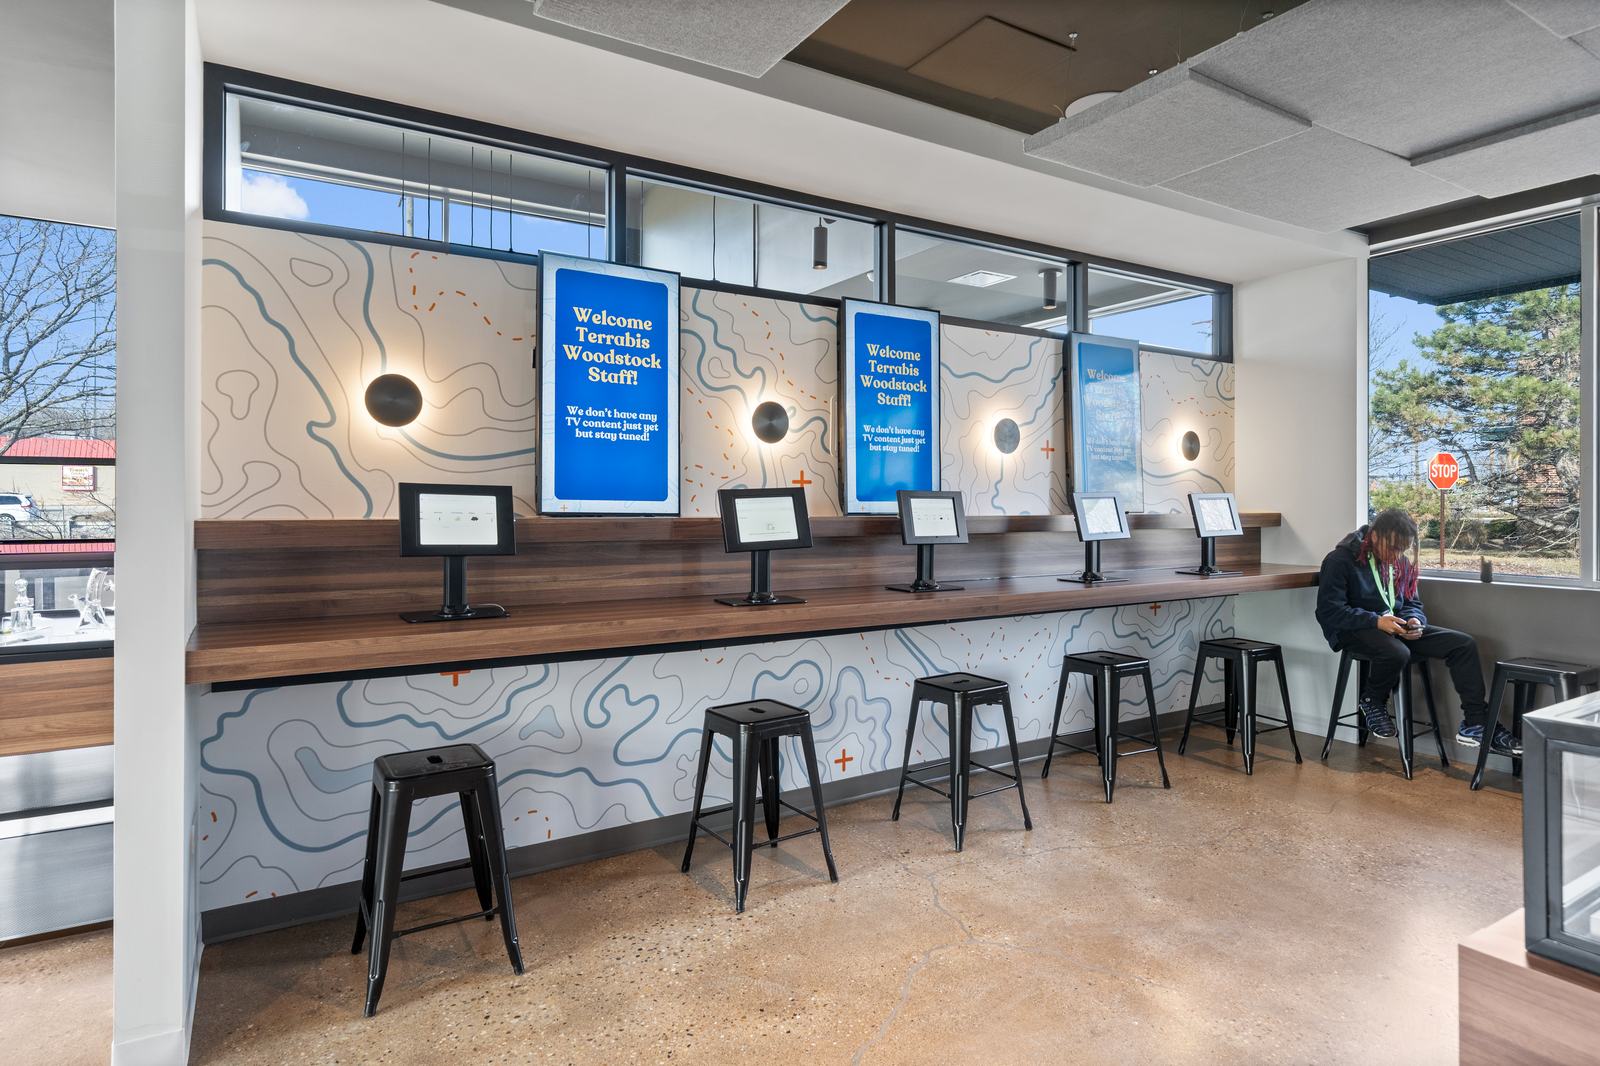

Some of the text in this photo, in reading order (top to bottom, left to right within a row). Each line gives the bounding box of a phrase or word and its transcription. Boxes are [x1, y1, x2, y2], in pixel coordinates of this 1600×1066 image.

[573, 306, 653, 331] Welcome
[575, 326, 650, 349] Terrabis
[562, 344, 662, 369] Woodstock
[866, 343, 921, 361] Welcome
[588, 366, 638, 386] Staff!
[868, 359, 920, 377] Terrabis
[860, 374, 928, 393] Woodstock
[877, 391, 912, 407] Staff!
[566, 405, 584, 416] We
[613, 408, 638, 420] have
[638, 412, 657, 423] any
[565, 416, 659, 433] TV content just yet
[863, 424, 875, 433] We
[894, 426, 911, 435] have
[911, 429, 925, 437] any
[575, 428, 650, 442] but stay tuned!
[862, 433, 874, 442] TV
[900, 435, 915, 445] just
[869, 442, 920, 454] but stay tuned!
[1431, 463, 1457, 478] STOP
